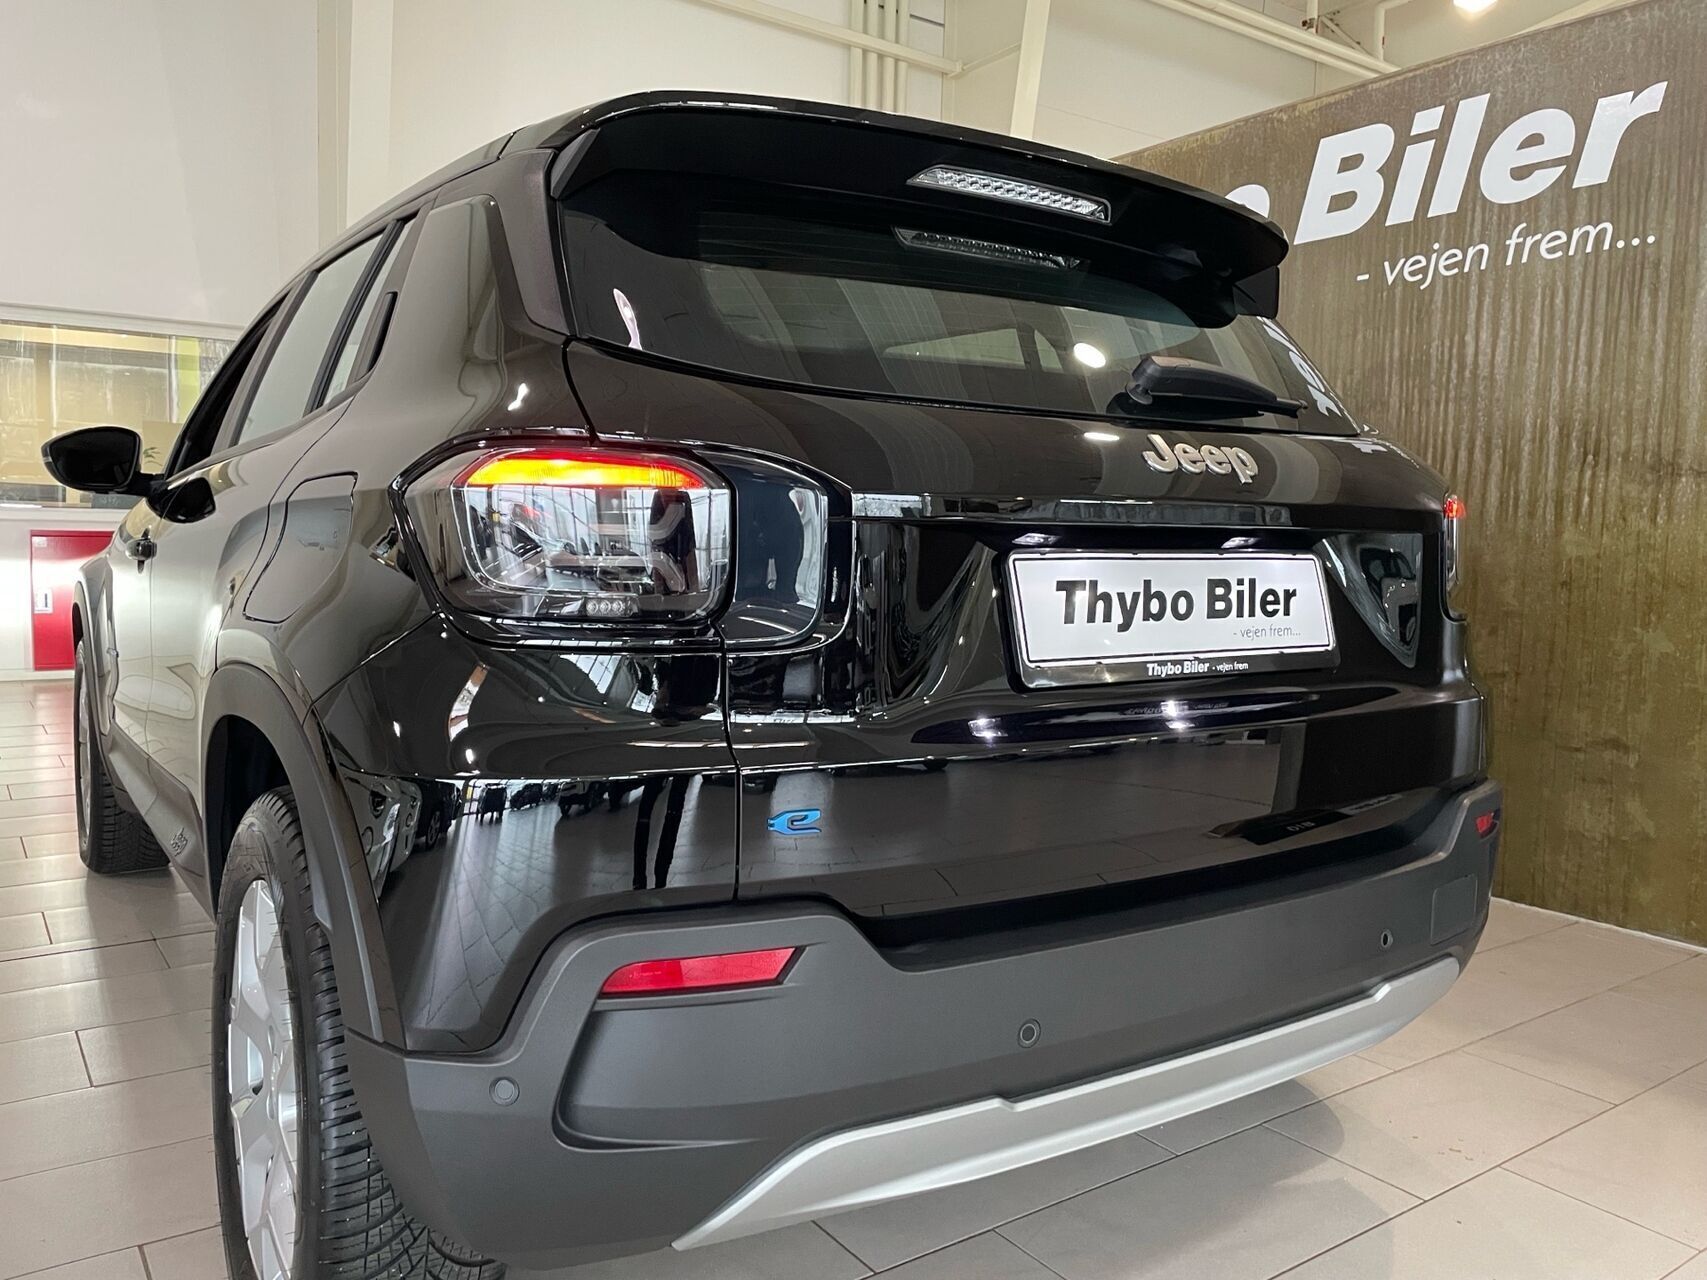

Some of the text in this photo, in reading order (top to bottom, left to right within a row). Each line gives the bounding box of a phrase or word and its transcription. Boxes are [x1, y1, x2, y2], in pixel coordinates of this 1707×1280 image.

[1294, 81, 1668, 245] Biler
[1383, 243, 1489, 290] vejen
[1504, 222, 1656, 266] frem...
[1142, 433, 1258, 485] Jeep
[1055, 577, 1297, 633] Thybo Biler
[1240, 626, 1267, 640] vejen
[1146, 662, 1181, 678] Thybo
[1183, 661, 1210, 674] Biler
[1216, 662, 1234, 673] vejen
[1234, 661, 1249, 670] frem
